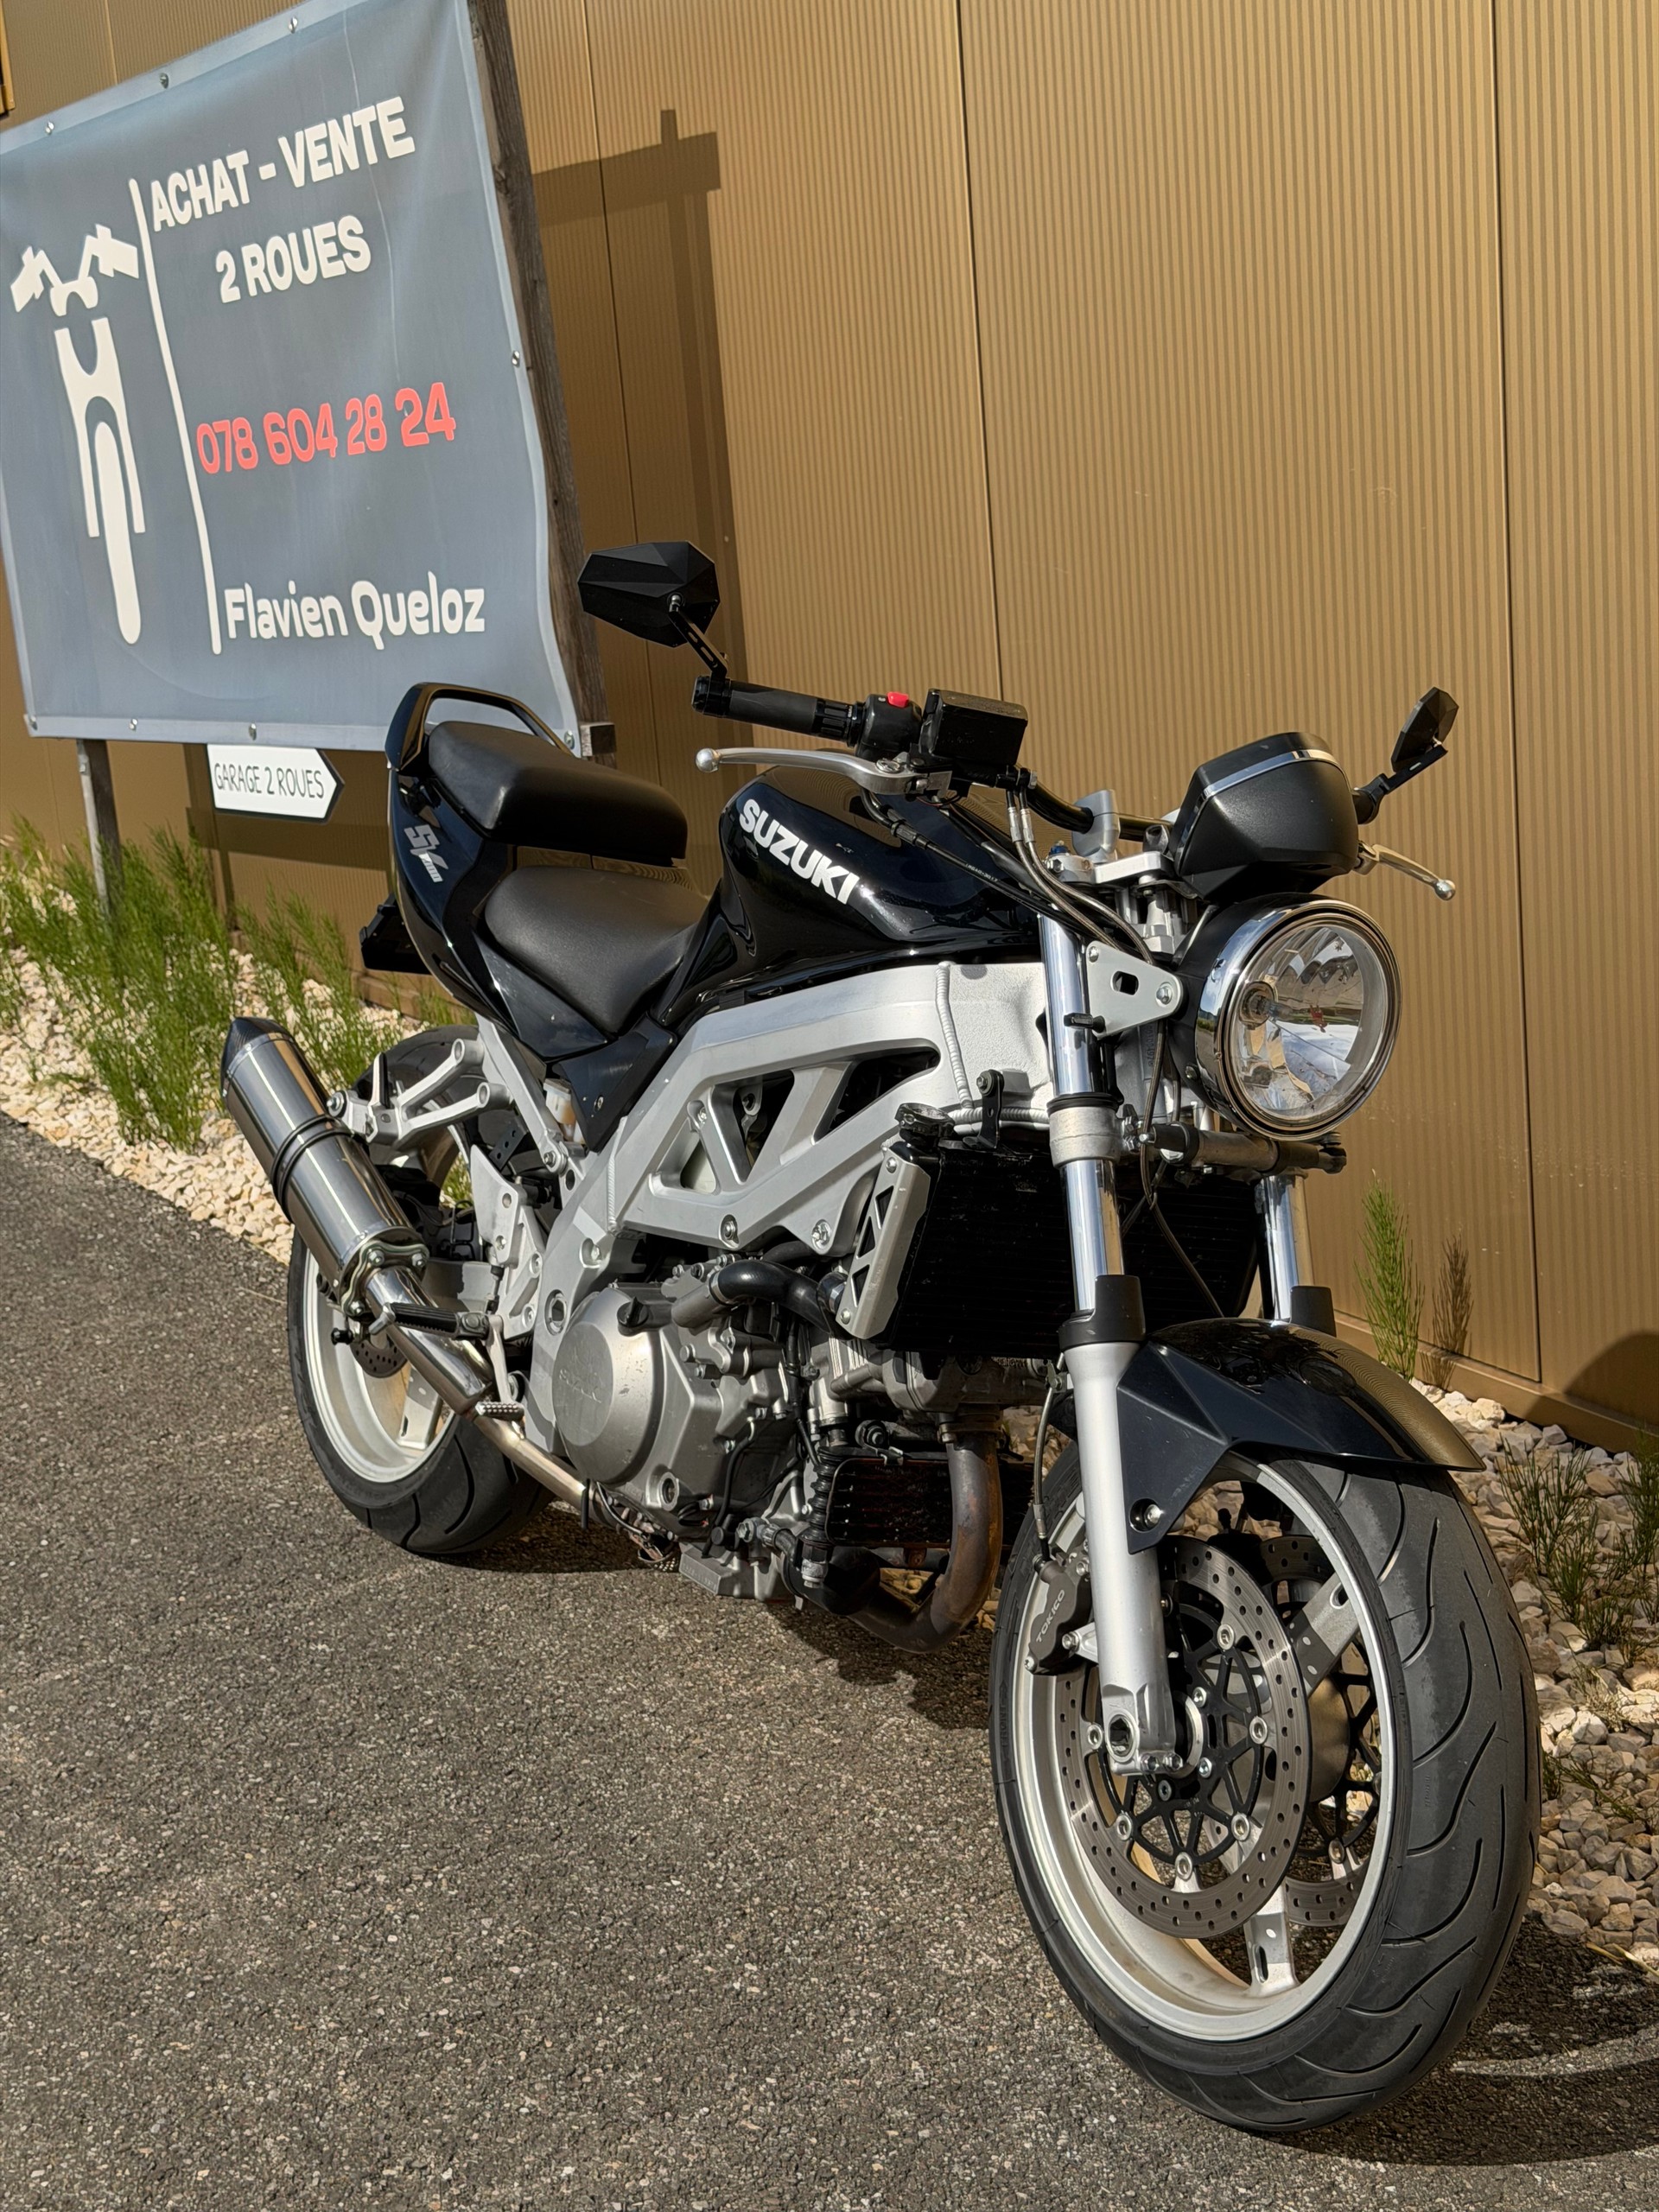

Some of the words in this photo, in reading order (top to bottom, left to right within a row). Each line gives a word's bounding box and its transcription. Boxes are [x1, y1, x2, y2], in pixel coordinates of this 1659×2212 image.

[150, 149, 251, 232] ACHAT
[258, 162, 277, 181] -
[277, 96, 416, 188] VENTE
[215, 250, 242, 303] 2
[241, 214, 372, 297] ROUES
[195, 416, 259, 475] 078
[262, 402, 339, 466] 604
[344, 393, 388, 456] 28
[393, 381, 457, 448] 24
[225, 580, 349, 639] Flavien
[351, 571, 486, 651] Queloz
[213, 763, 263, 794] GARAGE
[264, 766, 276, 795] 2
[276, 766, 325, 799] ROUES
[739, 798, 860, 905] SUZUKI
[1036, 1589, 1065, 1643] TOKICO
